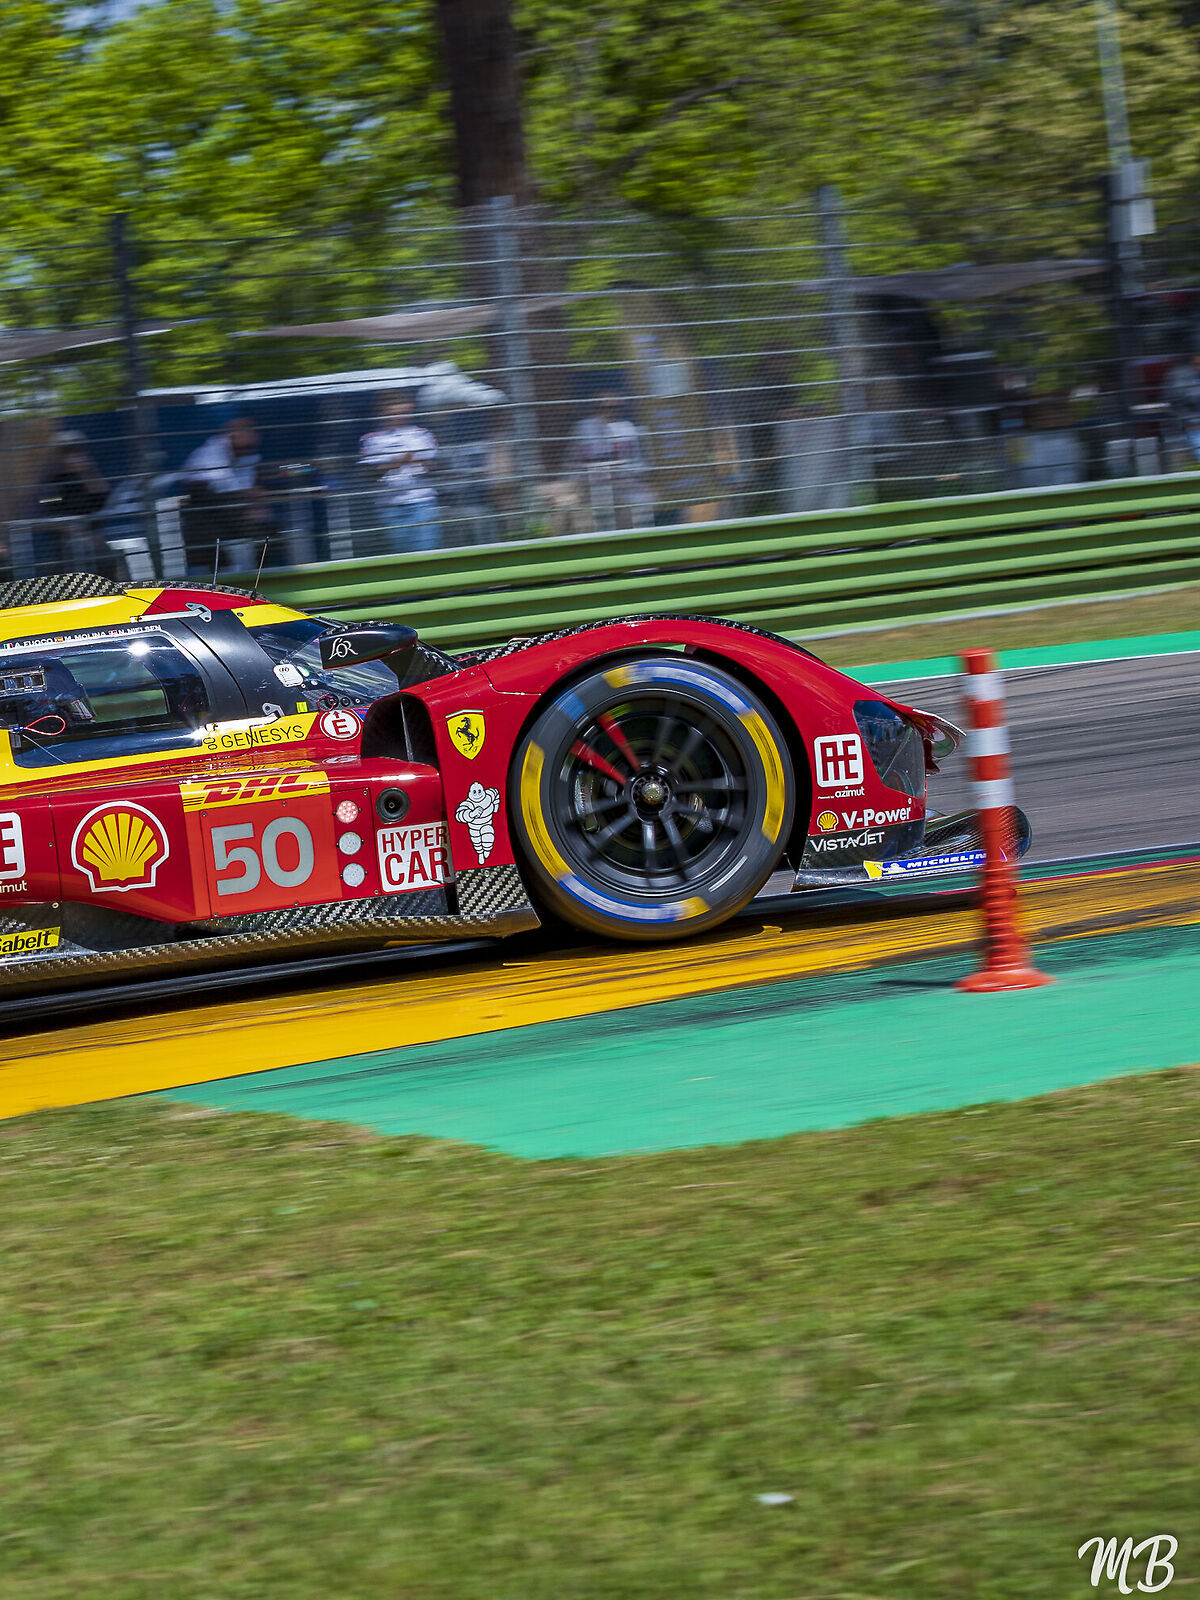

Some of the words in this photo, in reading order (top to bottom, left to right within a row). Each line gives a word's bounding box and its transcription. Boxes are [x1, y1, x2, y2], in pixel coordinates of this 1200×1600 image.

[23, 638, 53, 647] FUOCO
[221, 725, 305, 748] GENESYS
[332, 718, 350, 736] E
[203, 774, 310, 804] DHL
[834, 785, 865, 799] azimut
[841, 806, 912, 829] V-Power
[381, 825, 448, 853] HYPER
[211, 816, 316, 896] 50
[384, 846, 451, 886] CAR
[906, 852, 987, 868] MICHELIN
